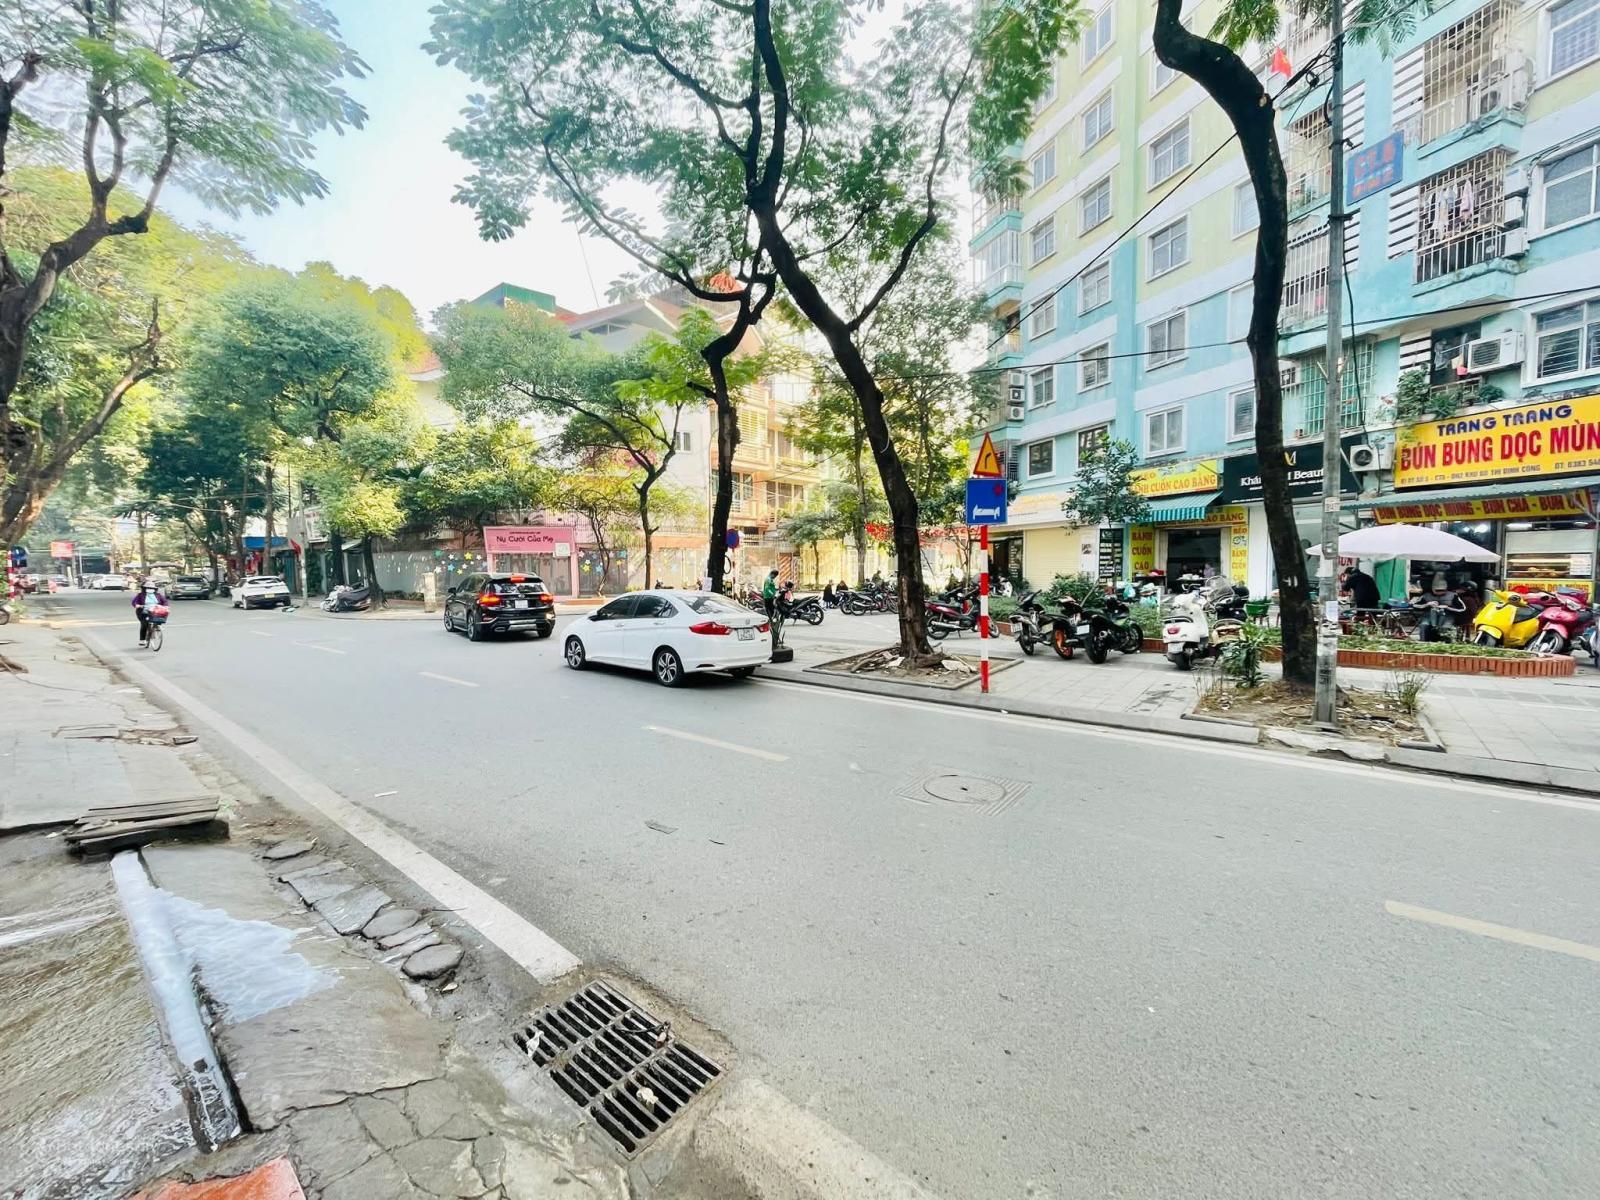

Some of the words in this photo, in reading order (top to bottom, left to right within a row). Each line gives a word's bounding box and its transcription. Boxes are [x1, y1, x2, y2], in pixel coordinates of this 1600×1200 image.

[1437, 416, 1497, 437] TRANG
[1503, 404, 1572, 427] TRANG
[1400, 440, 1437, 471] BÚN
[1442, 436, 1493, 467] BUNG
[1500, 430, 1542, 463] DỌC
[1173, 479, 1190, 490] CAO
